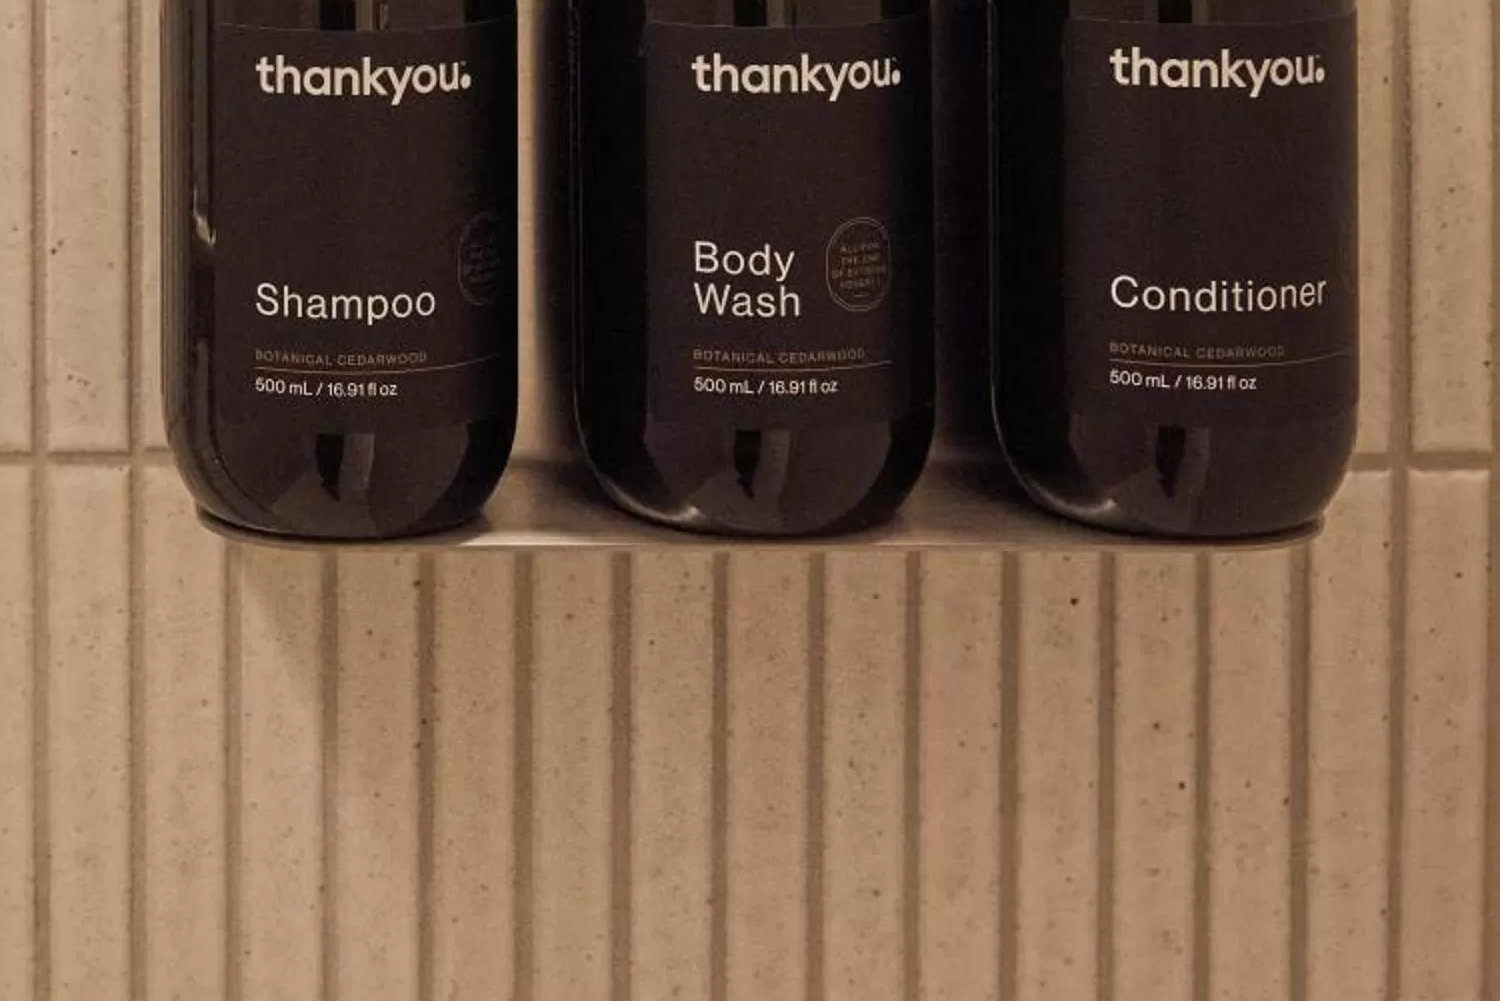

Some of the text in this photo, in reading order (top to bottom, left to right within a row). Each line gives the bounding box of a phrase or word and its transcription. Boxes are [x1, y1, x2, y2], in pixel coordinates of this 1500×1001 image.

[694, 240, 795, 282] Body
[255, 282, 437, 326] Shampoo
[693, 282, 801, 318] Wash
[1110, 274, 1327, 313] Conditioner
[254, 349, 428, 367] BOTANICAL CEDARWOOD
[692, 347, 866, 365] BOTANICAL CEDARWOOD
[1109, 342, 1285, 360] BOTANICAL CEDARWOOD
[255, 377, 286, 395] 500
[288, 381, 313, 396] mL
[327, 382, 365, 398] 16.91
[379, 384, 399, 397] oz
[693, 376, 727, 394] 500
[729, 379, 755, 395] mL
[768, 380, 806, 395] 16.91
[819, 380, 839, 394] oz
[1109, 369, 1143, 387] 500
[1145, 373, 1171, 389] mL
[1185, 374, 1224, 390] 16.91
[1239, 376, 1257, 390] oz
